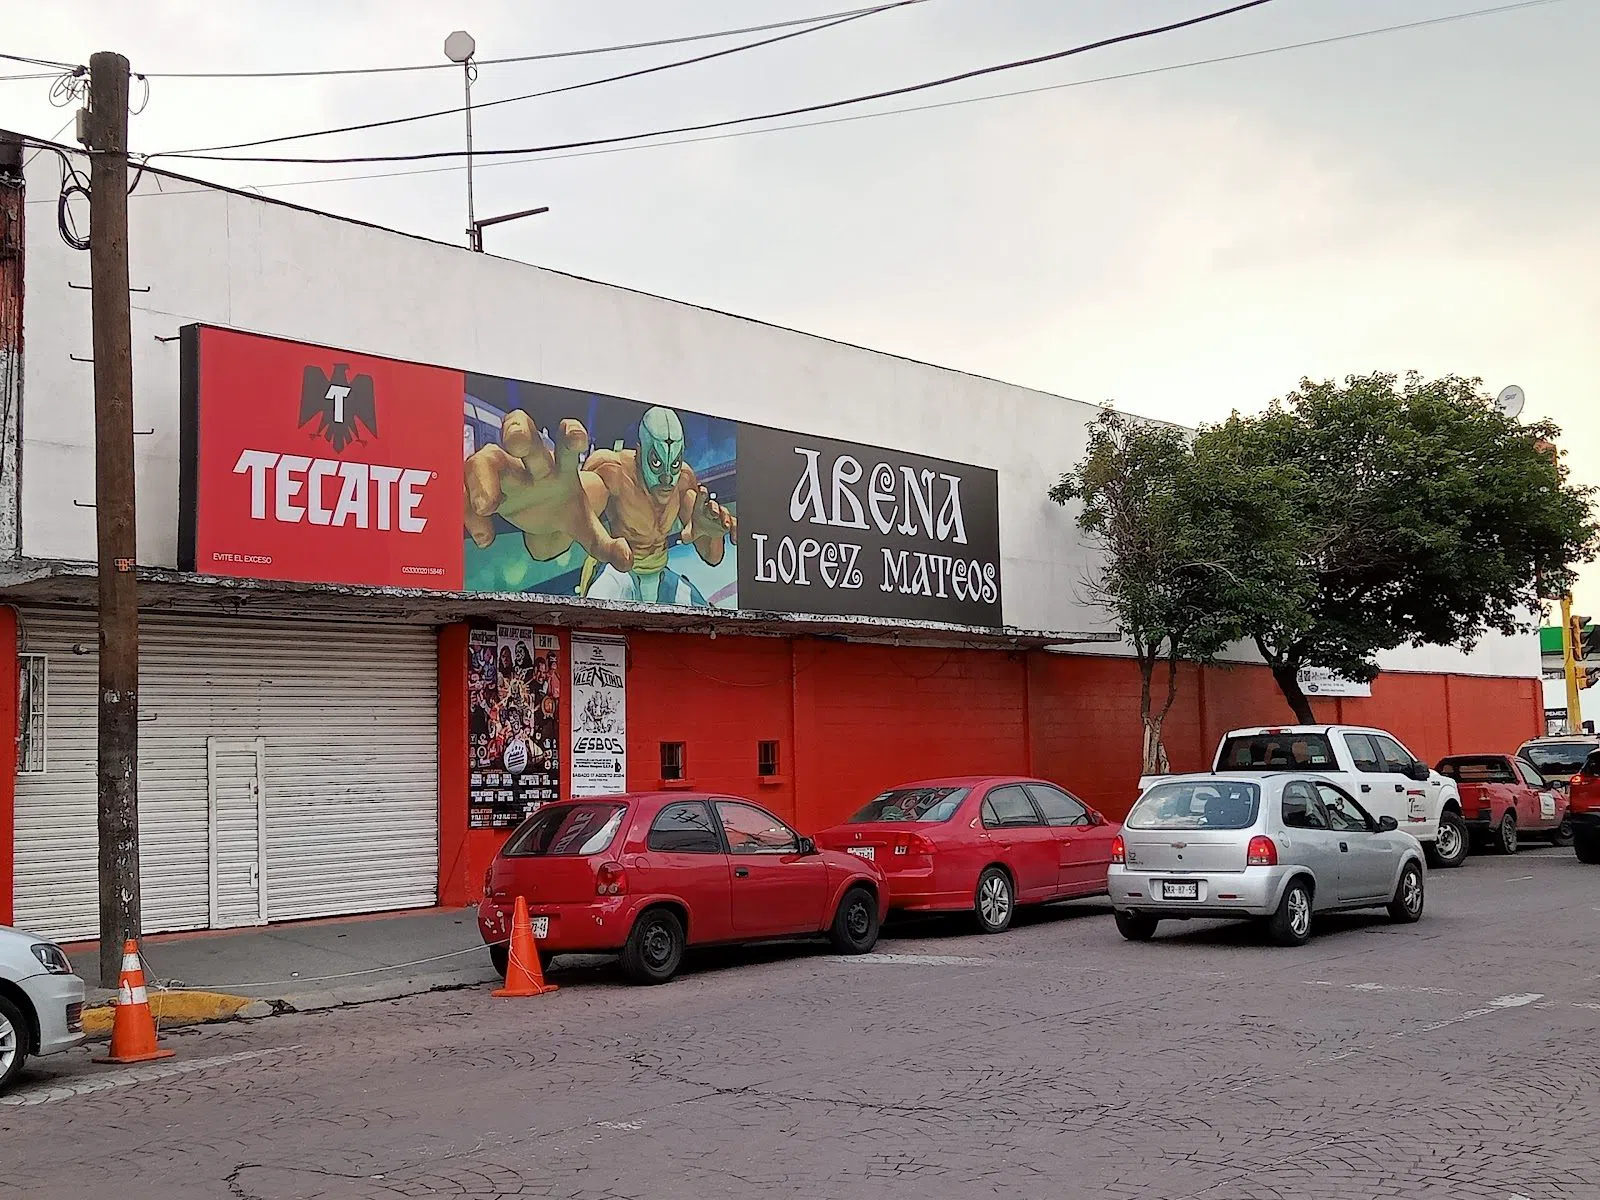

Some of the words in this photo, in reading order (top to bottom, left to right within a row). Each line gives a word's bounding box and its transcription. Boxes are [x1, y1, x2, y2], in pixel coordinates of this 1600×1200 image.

[325, 384, 351, 423] T
[232, 449, 432, 533] TECATE
[789, 447, 968, 544] ARENA
[213, 553, 233, 562] EVITE
[234, 554, 243, 562] EL
[244, 555, 272, 564] EXCESO
[752, 533, 863, 589] LOPEZ
[880, 548, 998, 604] MATEOS
[573, 736, 625, 754] LESBOS
